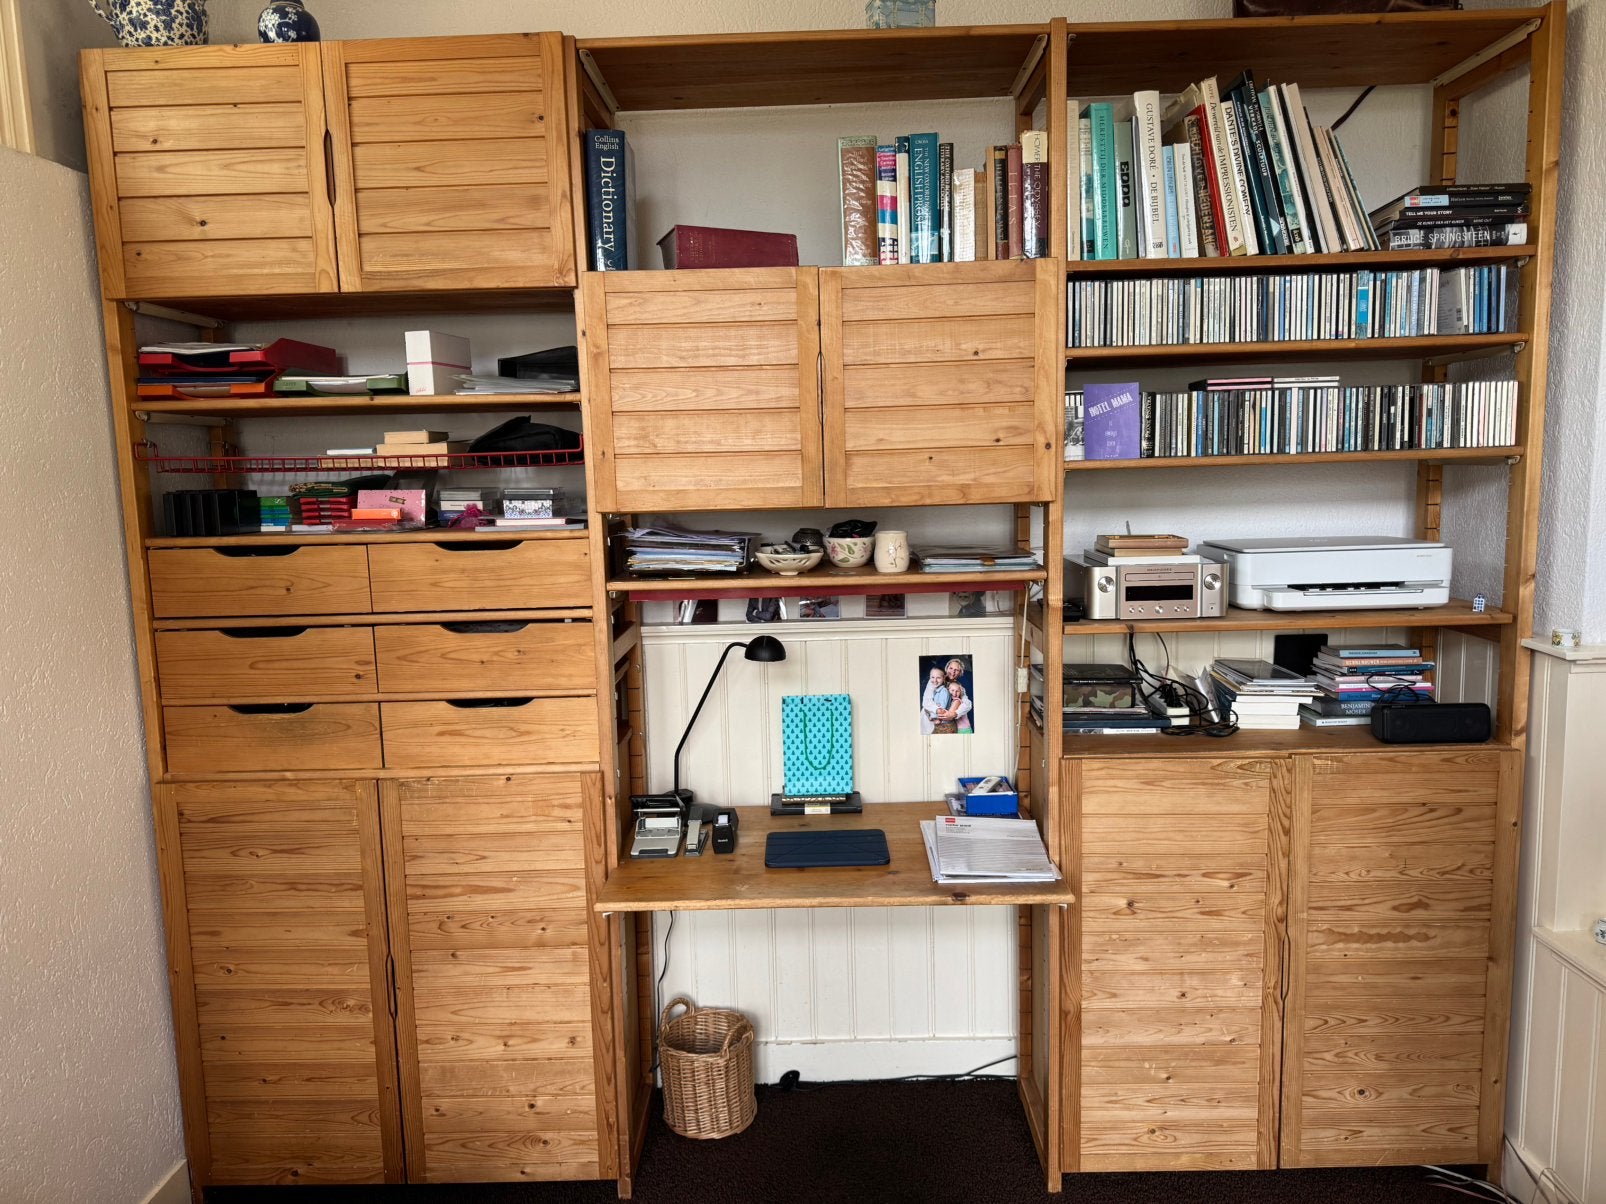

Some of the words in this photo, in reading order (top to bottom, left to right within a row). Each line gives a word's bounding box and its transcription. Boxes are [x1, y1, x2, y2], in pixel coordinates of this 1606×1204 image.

[1145, 103, 1156, 143] GUSTAVE
[595, 135, 619, 143] Collins
[595, 143, 619, 151] English
[1033, 134, 1041, 161] HOMER
[914, 148, 923, 192] ENGLISH
[1148, 145, 1158, 171] DORÉ
[1225, 107, 1238, 147] DANTE'S
[1232, 147, 1243, 177] DIVINE
[1238, 177, 1251, 216] COMEDY
[1033, 164, 1041, 180] THE
[1214, 133, 1222, 146] van
[1218, 155, 1238, 232] IMPRESSIONISTEN
[1008, 172, 1018, 225] ILIAS
[1150, 182, 1158, 194] DE
[598, 156, 618, 252] Dictionary
[1033, 181, 1041, 228] ODYSSEY
[1149, 195, 1159, 225] BIJBEL
[1394, 233, 1424, 244] BRUCE
[1428, 231, 1490, 243] SPRINGSTEEN
[1088, 401, 1111, 417] HOTEL
[1110, 392, 1133, 409] MAMA
[1144, 419, 1152, 438] FRANK
